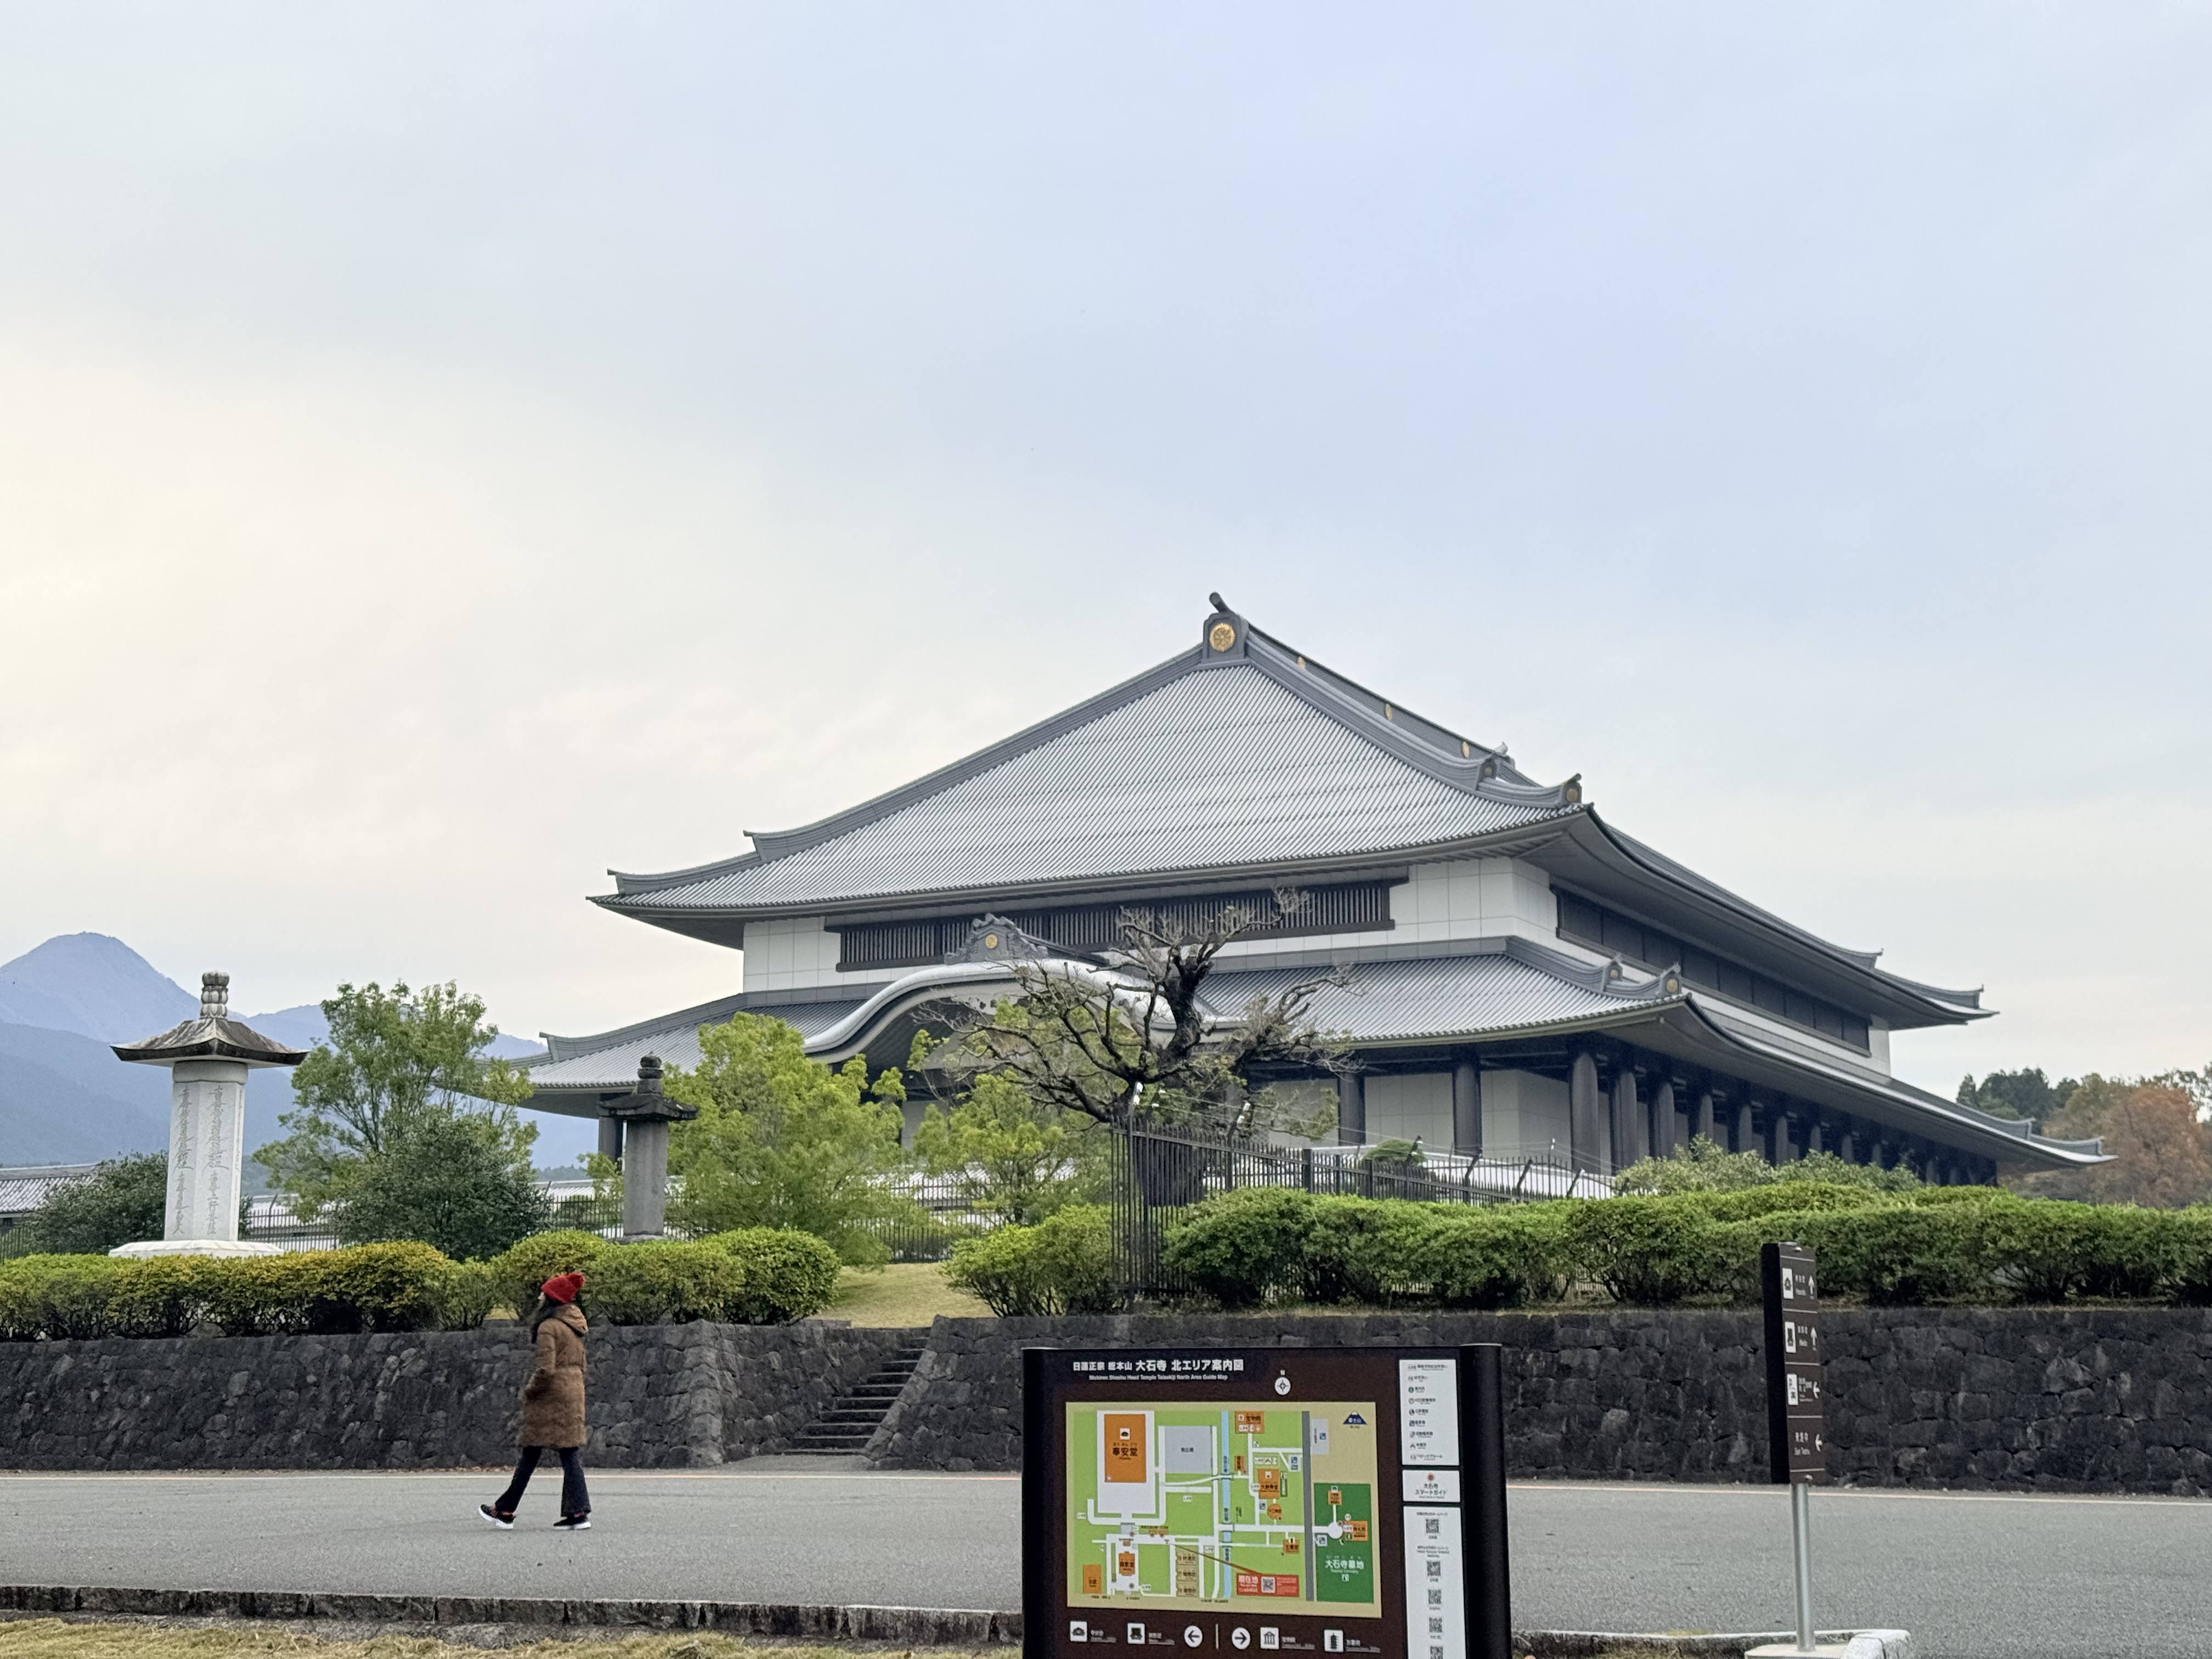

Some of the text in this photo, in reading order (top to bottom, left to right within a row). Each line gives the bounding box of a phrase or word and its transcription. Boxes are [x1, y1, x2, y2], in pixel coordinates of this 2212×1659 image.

[1073, 1359, 1244, 1372] 日蓮正宗 総本山 大石寺 北エリア案内図
[1113, 1447, 1138, 1457] 奉安堂
[1325, 1560, 1364, 1570] 大石寺墓地
